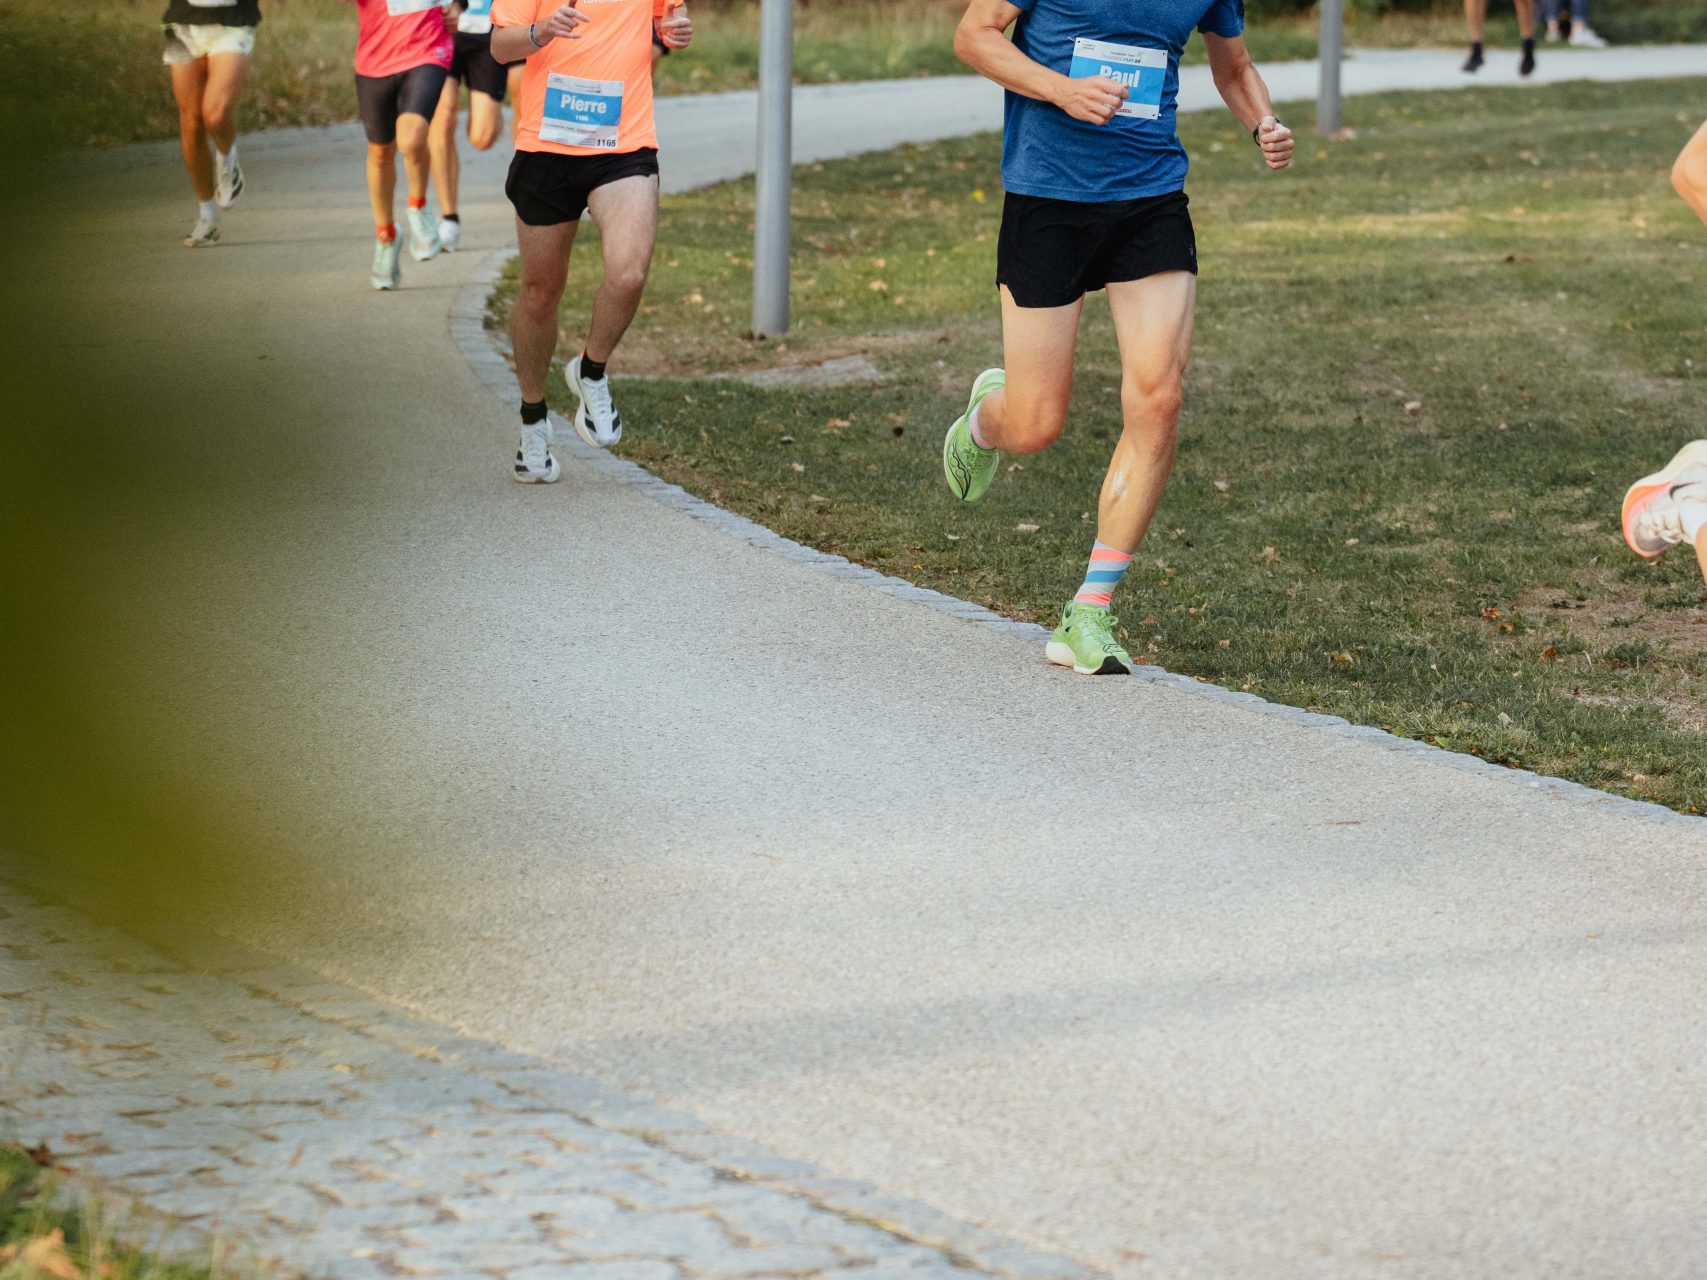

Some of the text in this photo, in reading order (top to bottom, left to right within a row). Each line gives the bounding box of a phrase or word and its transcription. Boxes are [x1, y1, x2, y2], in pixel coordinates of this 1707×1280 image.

[1099, 64, 1141, 88] Paul
[560, 93, 607, 114] Pierre
[597, 138, 616, 148] 1165
